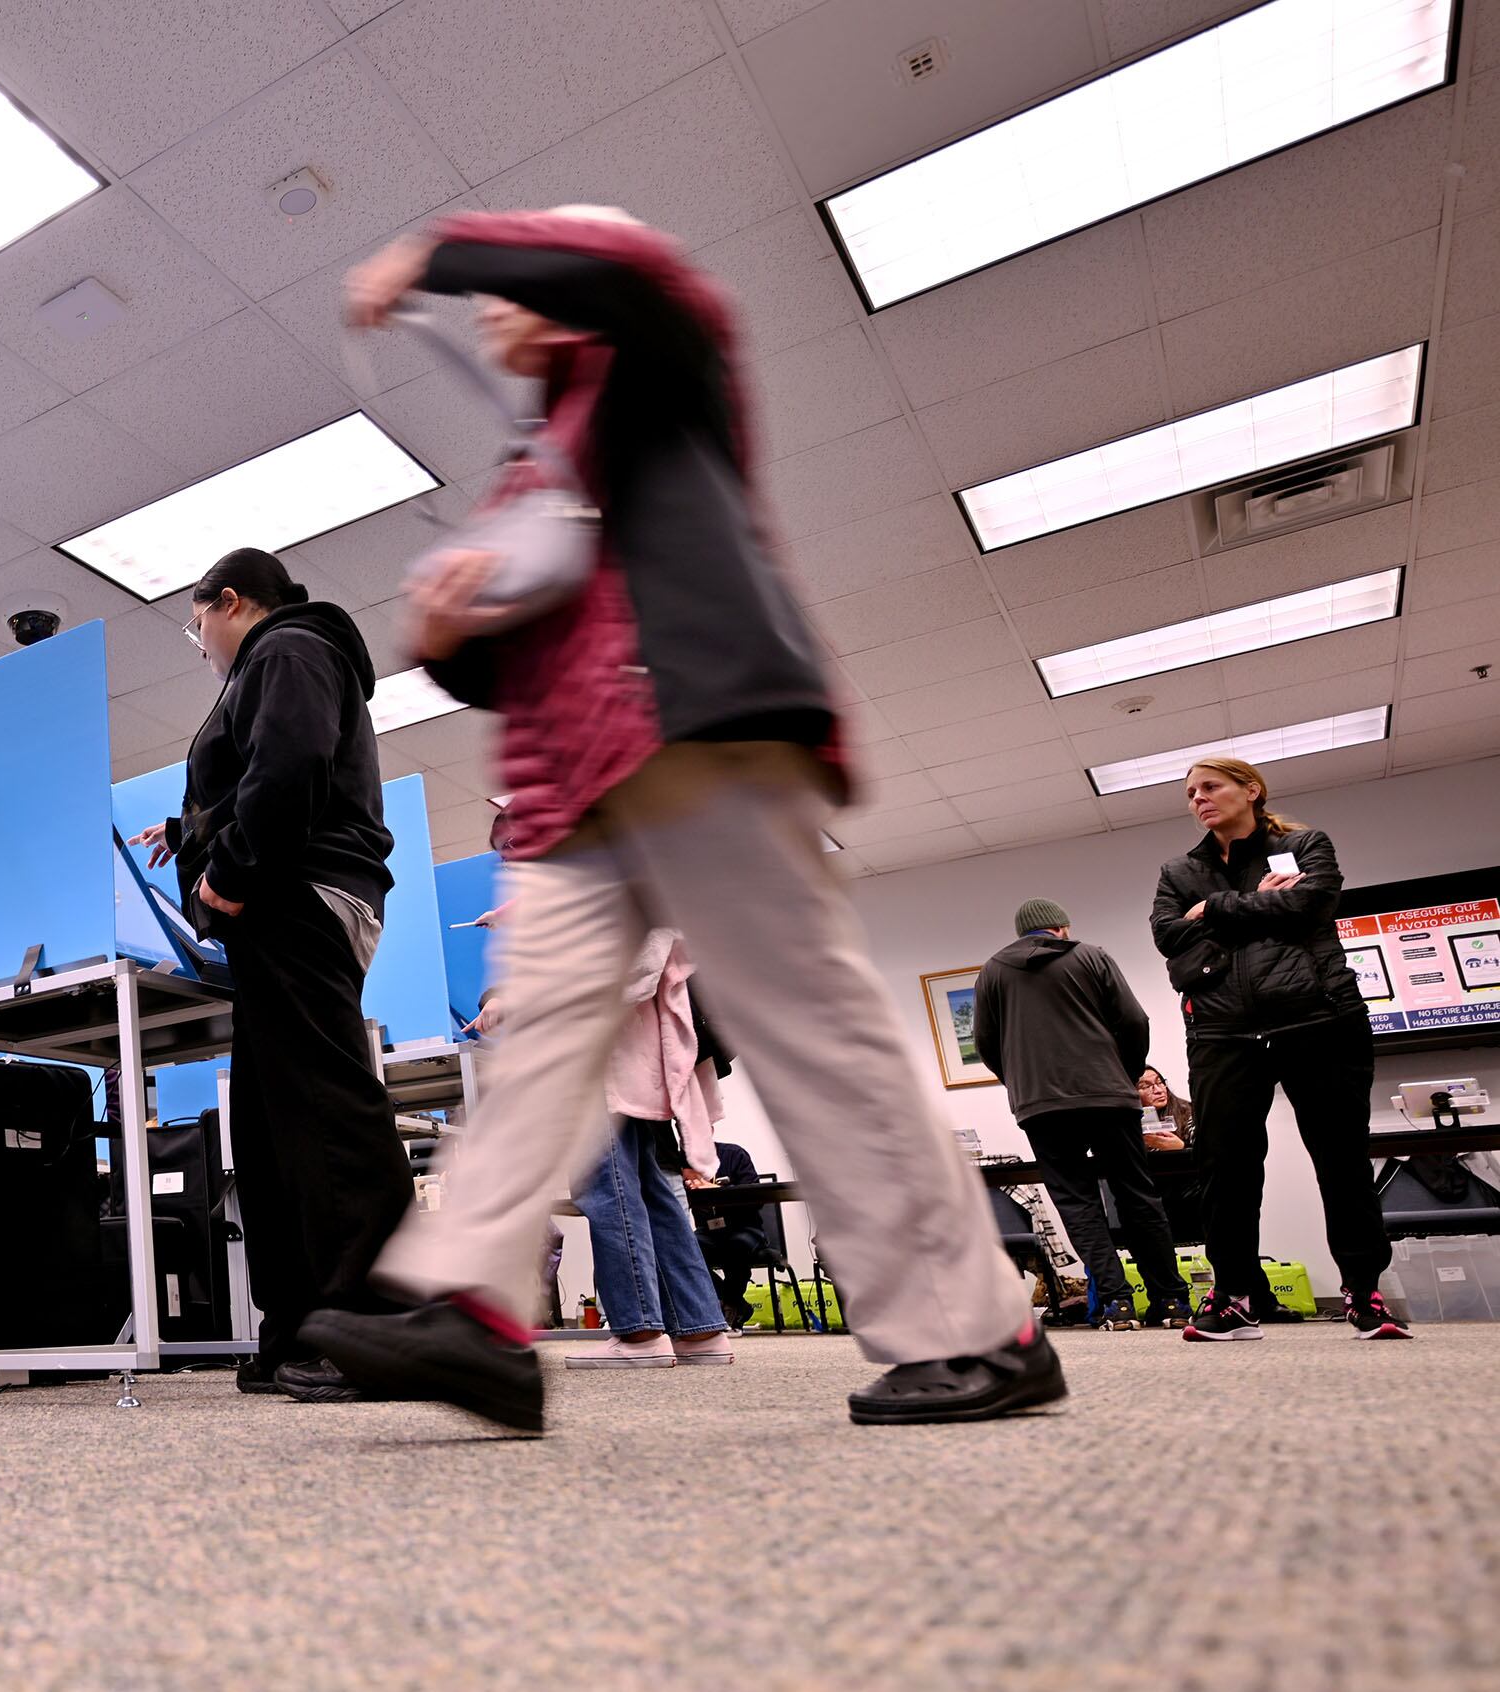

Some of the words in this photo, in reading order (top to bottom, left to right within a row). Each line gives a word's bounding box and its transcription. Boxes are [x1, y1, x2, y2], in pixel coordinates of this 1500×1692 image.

[1395, 904, 1453, 922] ¡ASEGURE
[1455, 902, 1481, 914] QUE
[1387, 922, 1404, 933] SU
[1405, 916, 1439, 930] VOTO
[1441, 911, 1494, 926] CUENTA!
[1418, 1009, 1431, 1018] NO
[1432, 1006, 1461, 1017] RETIRE
[1462, 1005, 1474, 1013] LA
[1412, 1018, 1441, 1027] HASTA
[1441, 1016, 1459, 1024] QUE
[1460, 1014, 1471, 1022] SE
[1472, 1013, 1484, 1021] LO
[1274, 1285, 1293, 1293] PAD
